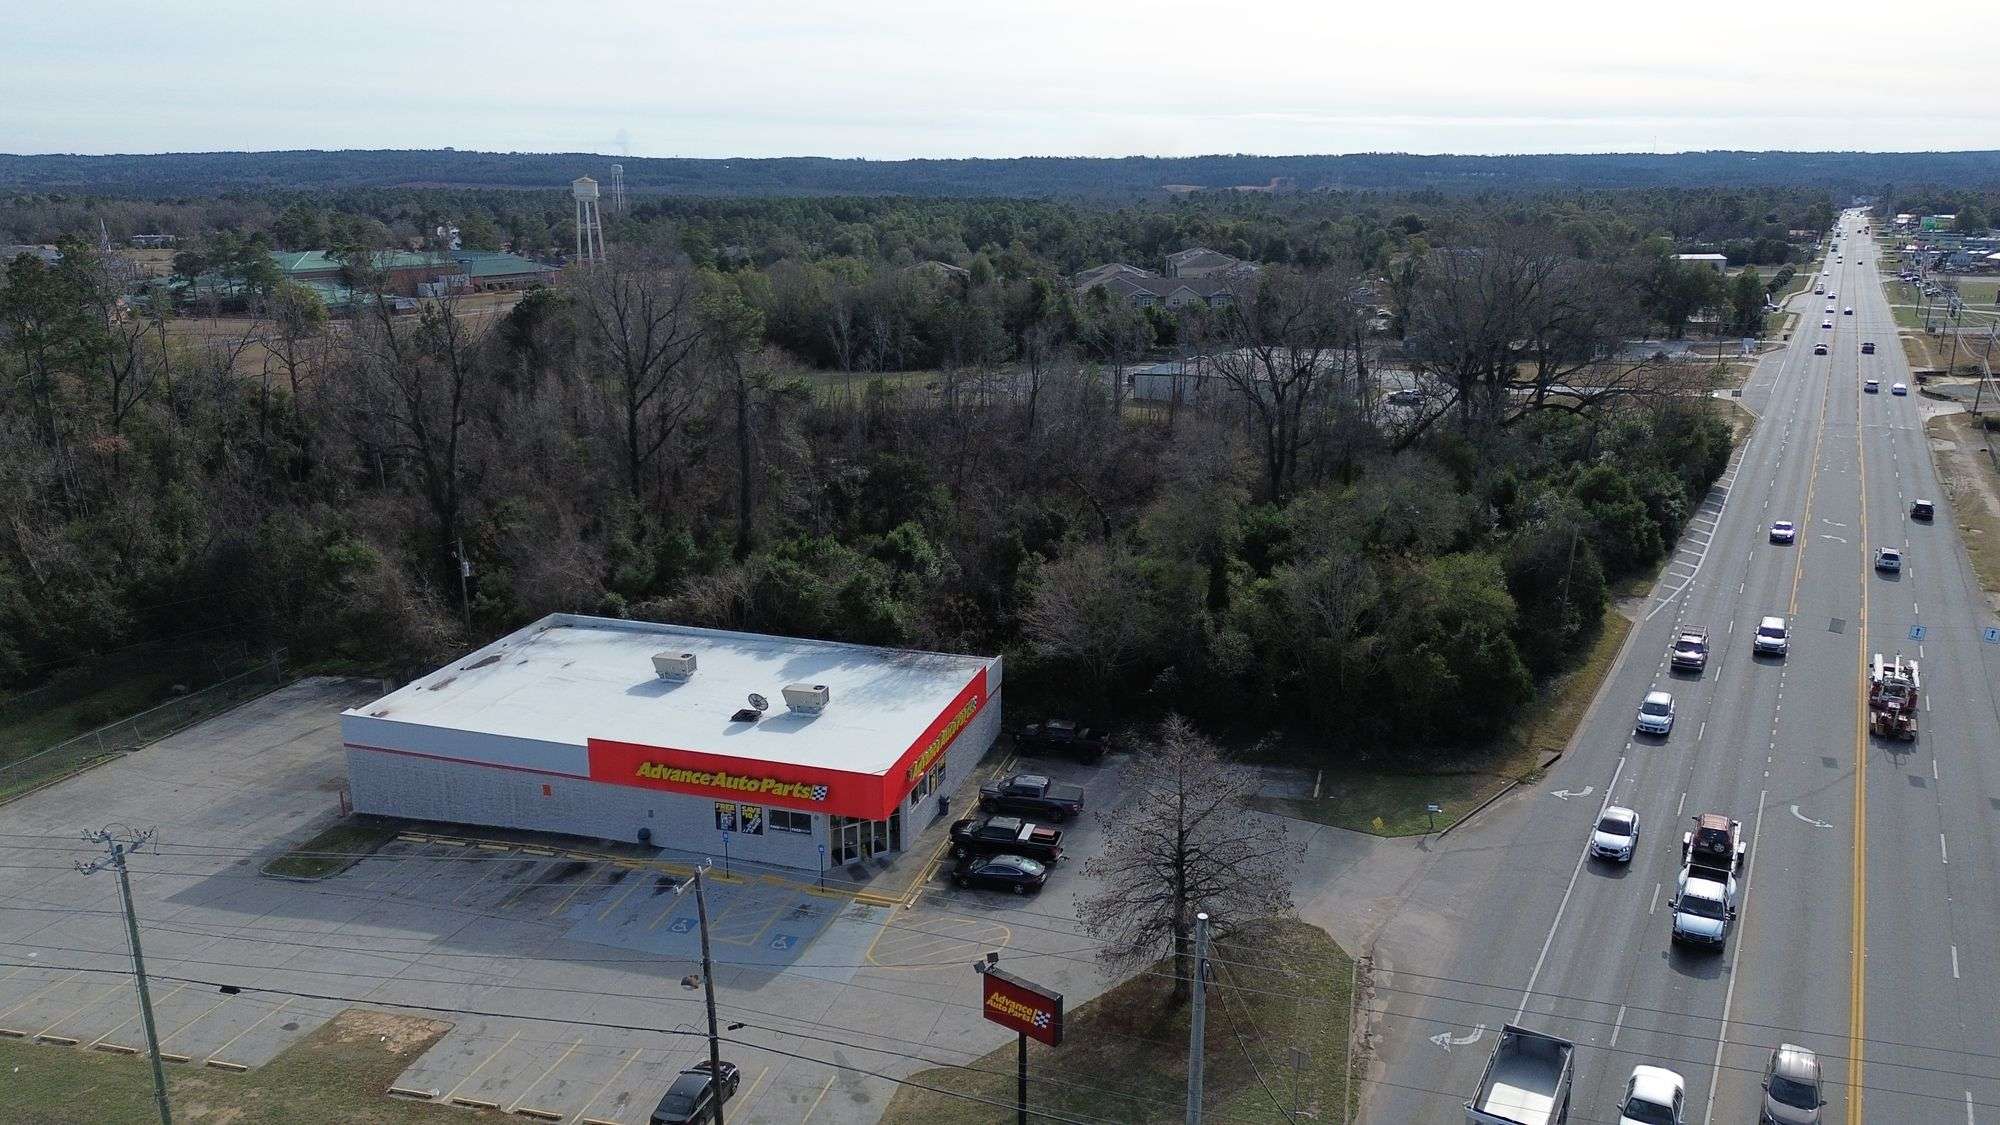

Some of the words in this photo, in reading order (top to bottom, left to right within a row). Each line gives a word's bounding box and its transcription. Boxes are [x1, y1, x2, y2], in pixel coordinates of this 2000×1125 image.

[635, 762, 710, 785] Advance
[710, 772, 760, 792] Auto
[760, 778, 811, 799] Parts
[986, 999, 1008, 1012] Auto
[1007, 1007, 1031, 1022] Parts
[990, 992, 1033, 1015] Advance
